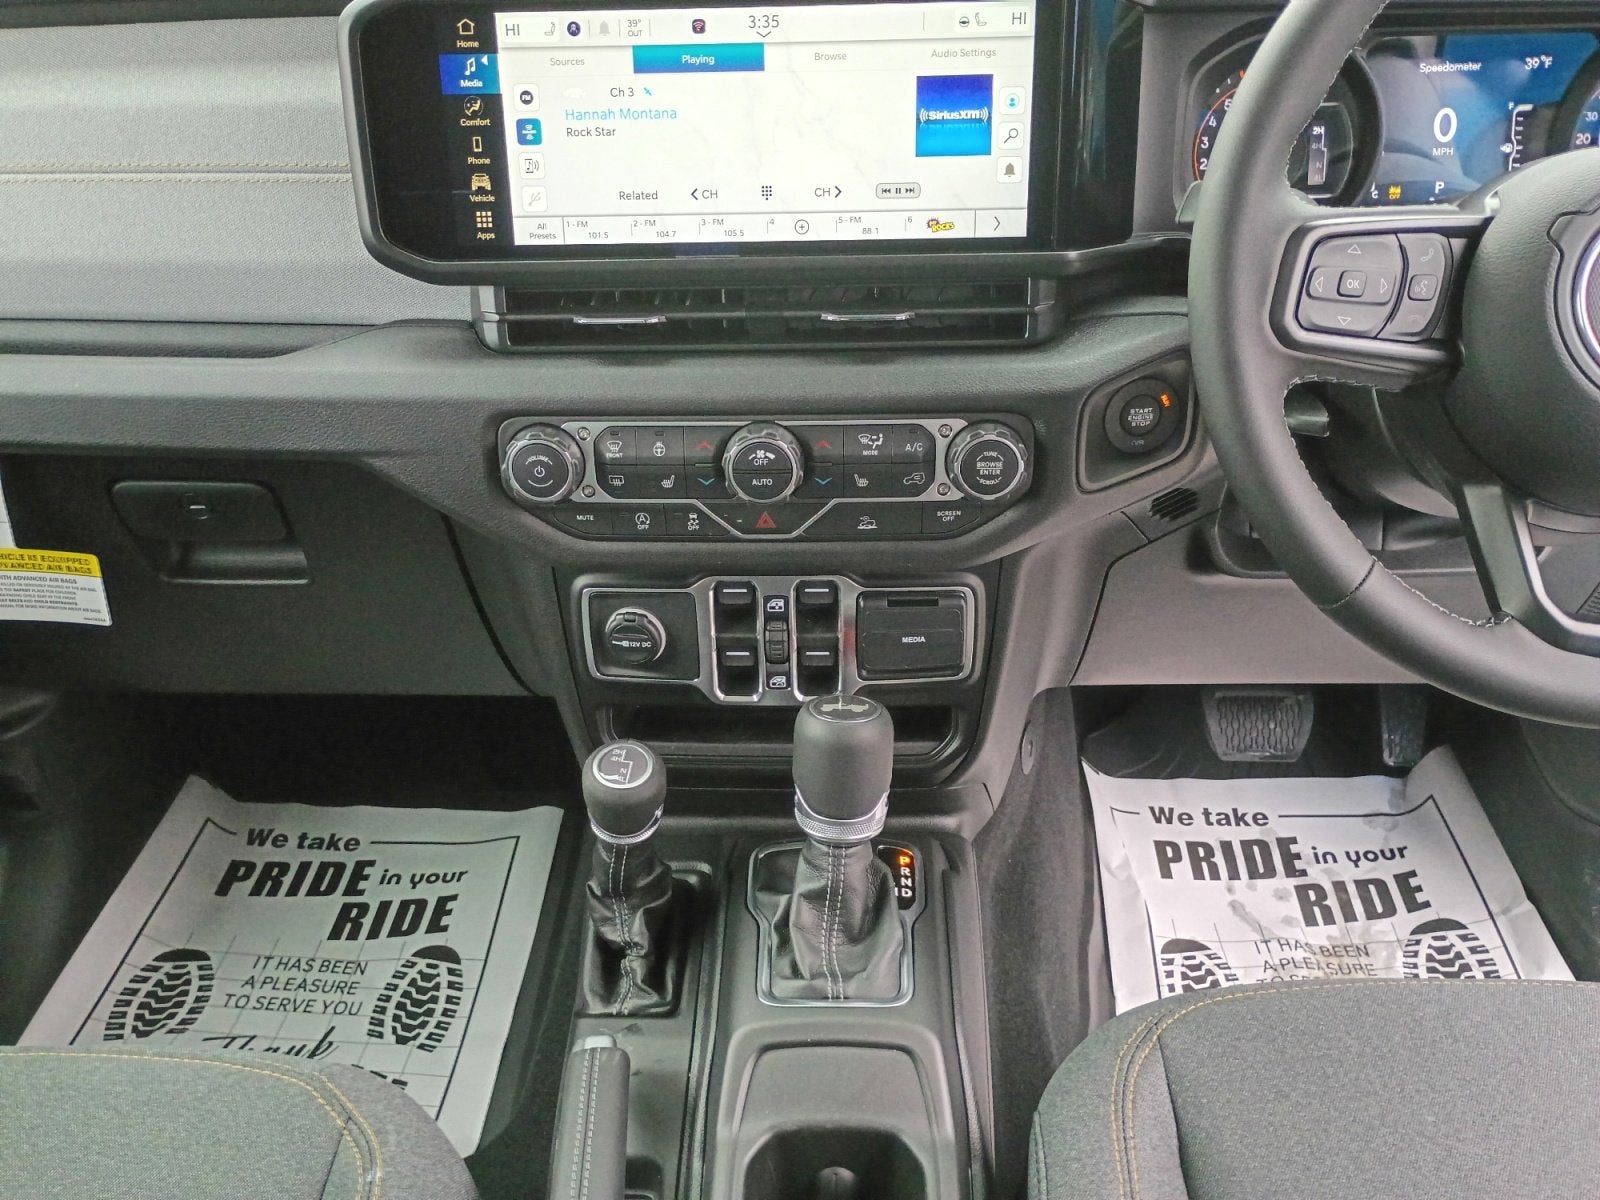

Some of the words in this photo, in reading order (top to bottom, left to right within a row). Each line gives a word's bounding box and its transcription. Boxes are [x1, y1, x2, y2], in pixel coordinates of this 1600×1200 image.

[748, 14, 780, 29] 3:35
[1012, 12, 1027, 26] HI
[504, 23, 520, 36] HI
[628, 29, 642, 38] OUT
[456, 40, 479, 48] Home
[814, 52, 848, 62] Browse
[930, 48, 958, 58] Audio
[960, 47, 997, 59] Settings
[550, 56, 585, 66] Sources
[682, 54, 716, 66] Playing
[1420, 60, 1482, 74] Speedometer
[460, 79, 483, 88] Media
[610, 88, 626, 98] Ch
[628, 88, 635, 98] 3
[565, 108, 617, 120] Hannah
[620, 107, 678, 120] Montana
[1584, 112, 1598, 122] 30
[460, 118, 490, 127] Comfort
[1208, 116, 1218, 128] 4
[1433, 106, 1458, 144] 0
[566, 126, 593, 138] Rock
[596, 126, 616, 138] Star
[1200, 136, 1209, 149] 3
[1576, 133, 1592, 144] 20
[1432, 147, 1454, 156] MPH
[468, 156, 490, 166] Phone
[1200, 158, 1208, 170] 2
[814, 186, 831, 198] CH
[1435, 181, 1444, 194] P
[470, 194, 496, 203] Vehicle
[619, 190, 658, 201] Related
[702, 188, 718, 200] CH
[850, 216, 862, 224] FM
[476, 232, 496, 241] Apps
[529, 232, 556, 240] Presets
[724, 230, 744, 238] 105.5
[862, 227, 879, 235] 88.1
[1346, 279, 1360, 289] OK
[906, 442, 924, 452] A/C
[979, 478, 1000, 486] SCROLL
[12, 575, 48, 583] ADVANCED
[1148, 806, 1194, 827] We
[1202, 806, 1270, 827] take
[246, 827, 288, 850] We
[297, 832, 361, 852] take
[900, 856, 910, 866] P
[1152, 836, 1309, 882] PRIDE
[1311, 846, 1338, 865] in
[1344, 844, 1408, 868] your
[900, 866, 911, 876] R
[214, 858, 378, 898] PRIDE
[379, 868, 402, 887] in
[408, 868, 468, 889] your
[900, 877, 912, 887] N
[902, 888, 912, 897] D
[1293, 870, 1432, 928] RIDE
[326, 894, 460, 941] RIDE
[1254, 940, 1272, 954] IT
[1278, 938, 1316, 956] HAS
[1319, 944, 1370, 958] BEEN
[252, 956, 274, 972] IT
[275, 956, 316, 974] HAS
[318, 958, 369, 976] BEEN
[1263, 960, 1277, 973] A
[1279, 956, 1378, 976] PLEASURE
[240, 975, 256, 990] A
[258, 976, 361, 996] PLEASURE
[224, 993, 252, 1010] TO
[252, 994, 320, 1014] SERVE
[321, 1000, 363, 1016] YOU
